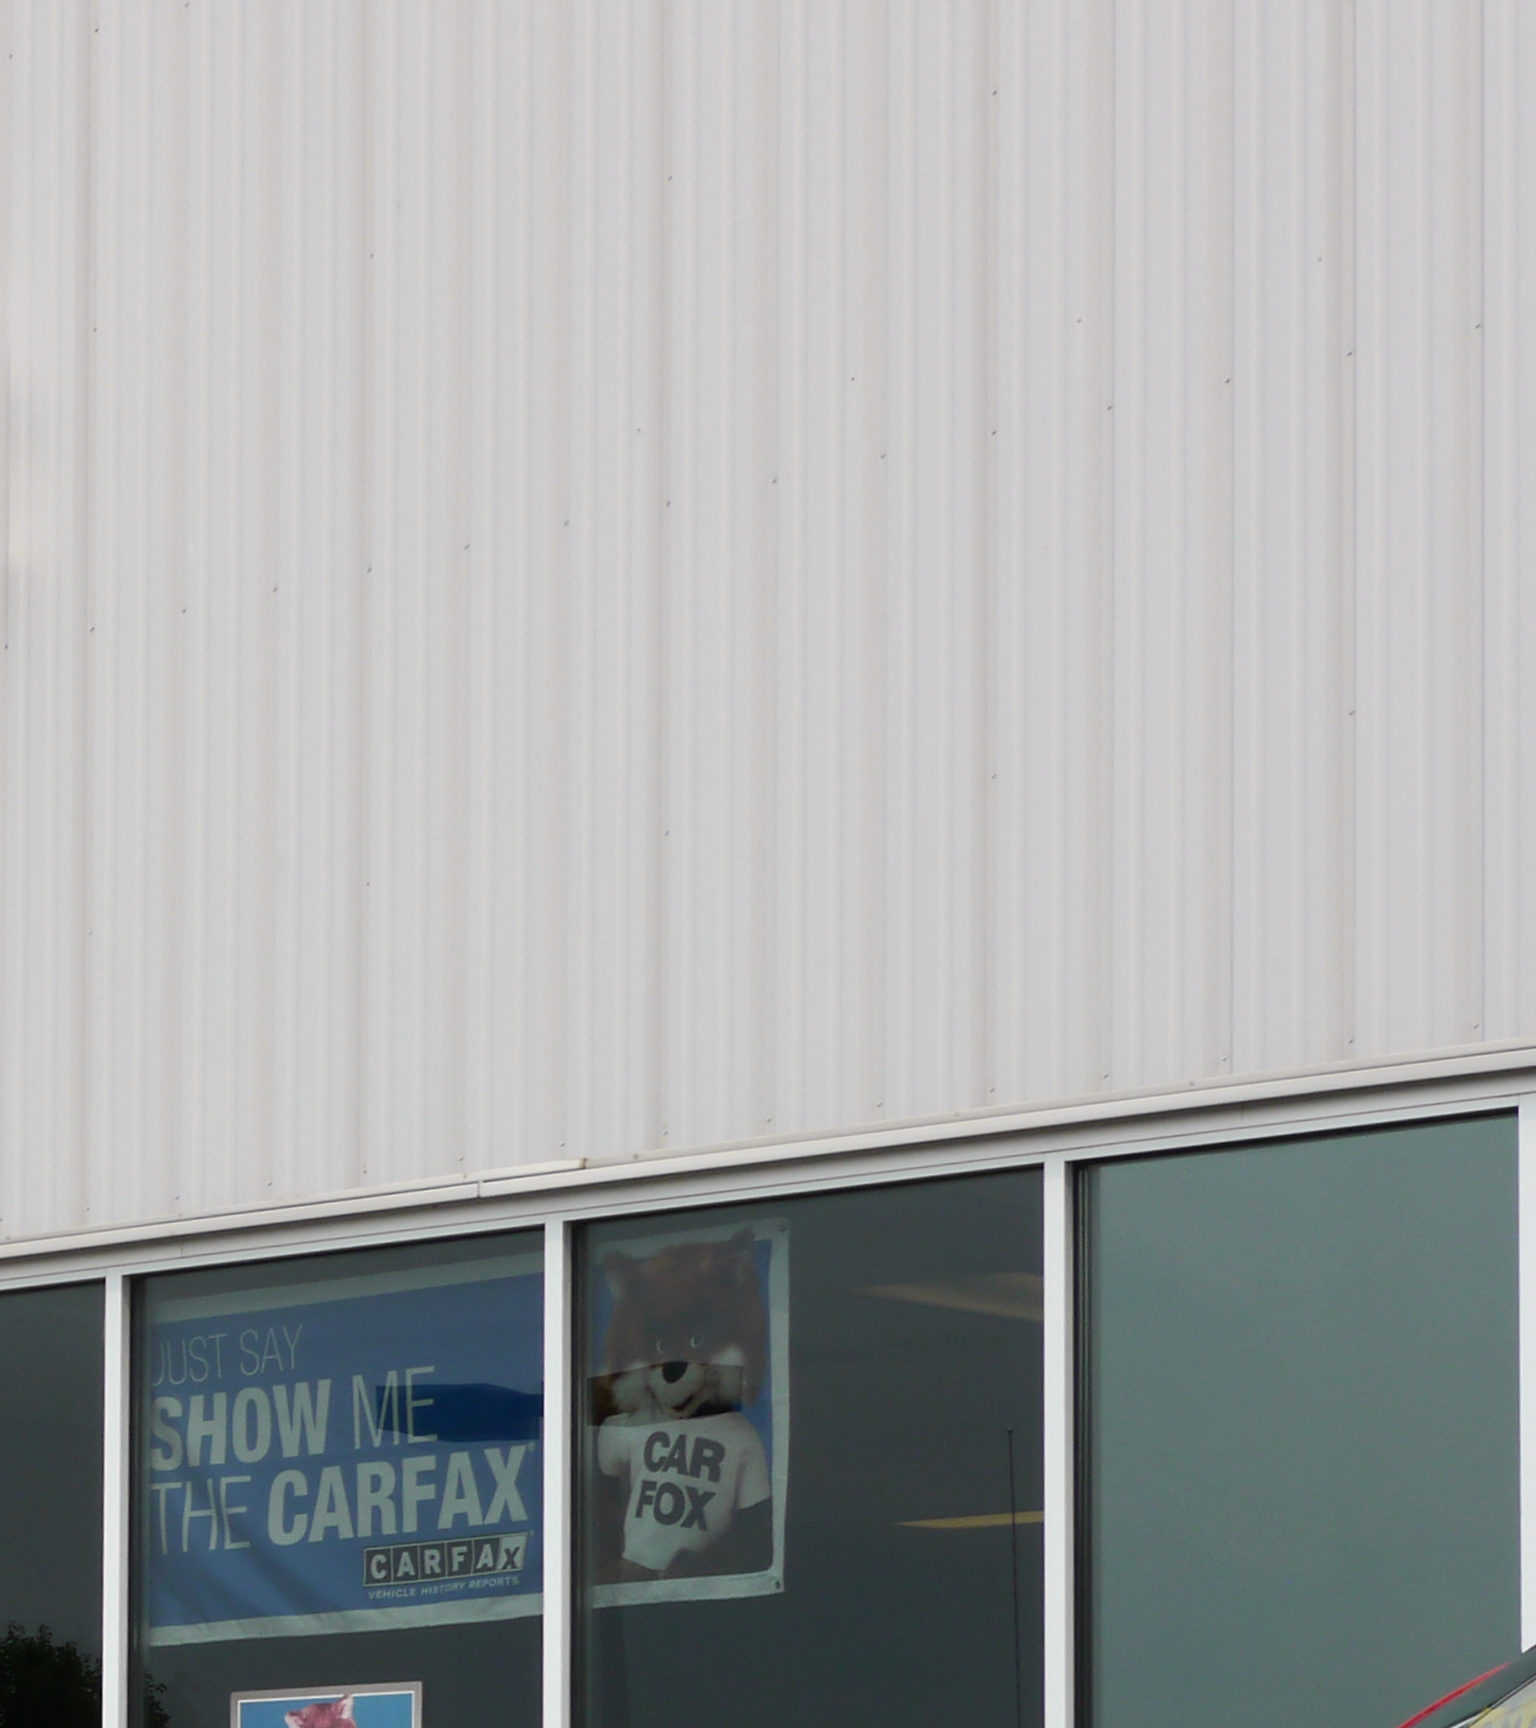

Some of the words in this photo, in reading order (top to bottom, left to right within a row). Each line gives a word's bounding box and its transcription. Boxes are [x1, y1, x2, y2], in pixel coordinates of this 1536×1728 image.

[153, 1333, 228, 1387] JUST
[239, 1323, 303, 1376] SAY
[151, 1379, 332, 1472] SHOW
[352, 1366, 438, 1450] ME
[643, 1431, 726, 1483] CAR
[151, 1475, 252, 1555] THE
[267, 1445, 529, 1546] CARFAX
[635, 1480, 717, 1532] FOX
[368, 1541, 523, 1581] CARFAX
[368, 1586, 417, 1600] VEHICLE
[420, 1581, 466, 1596] HISTORY
[468, 1576, 521, 1590] REPORTS
